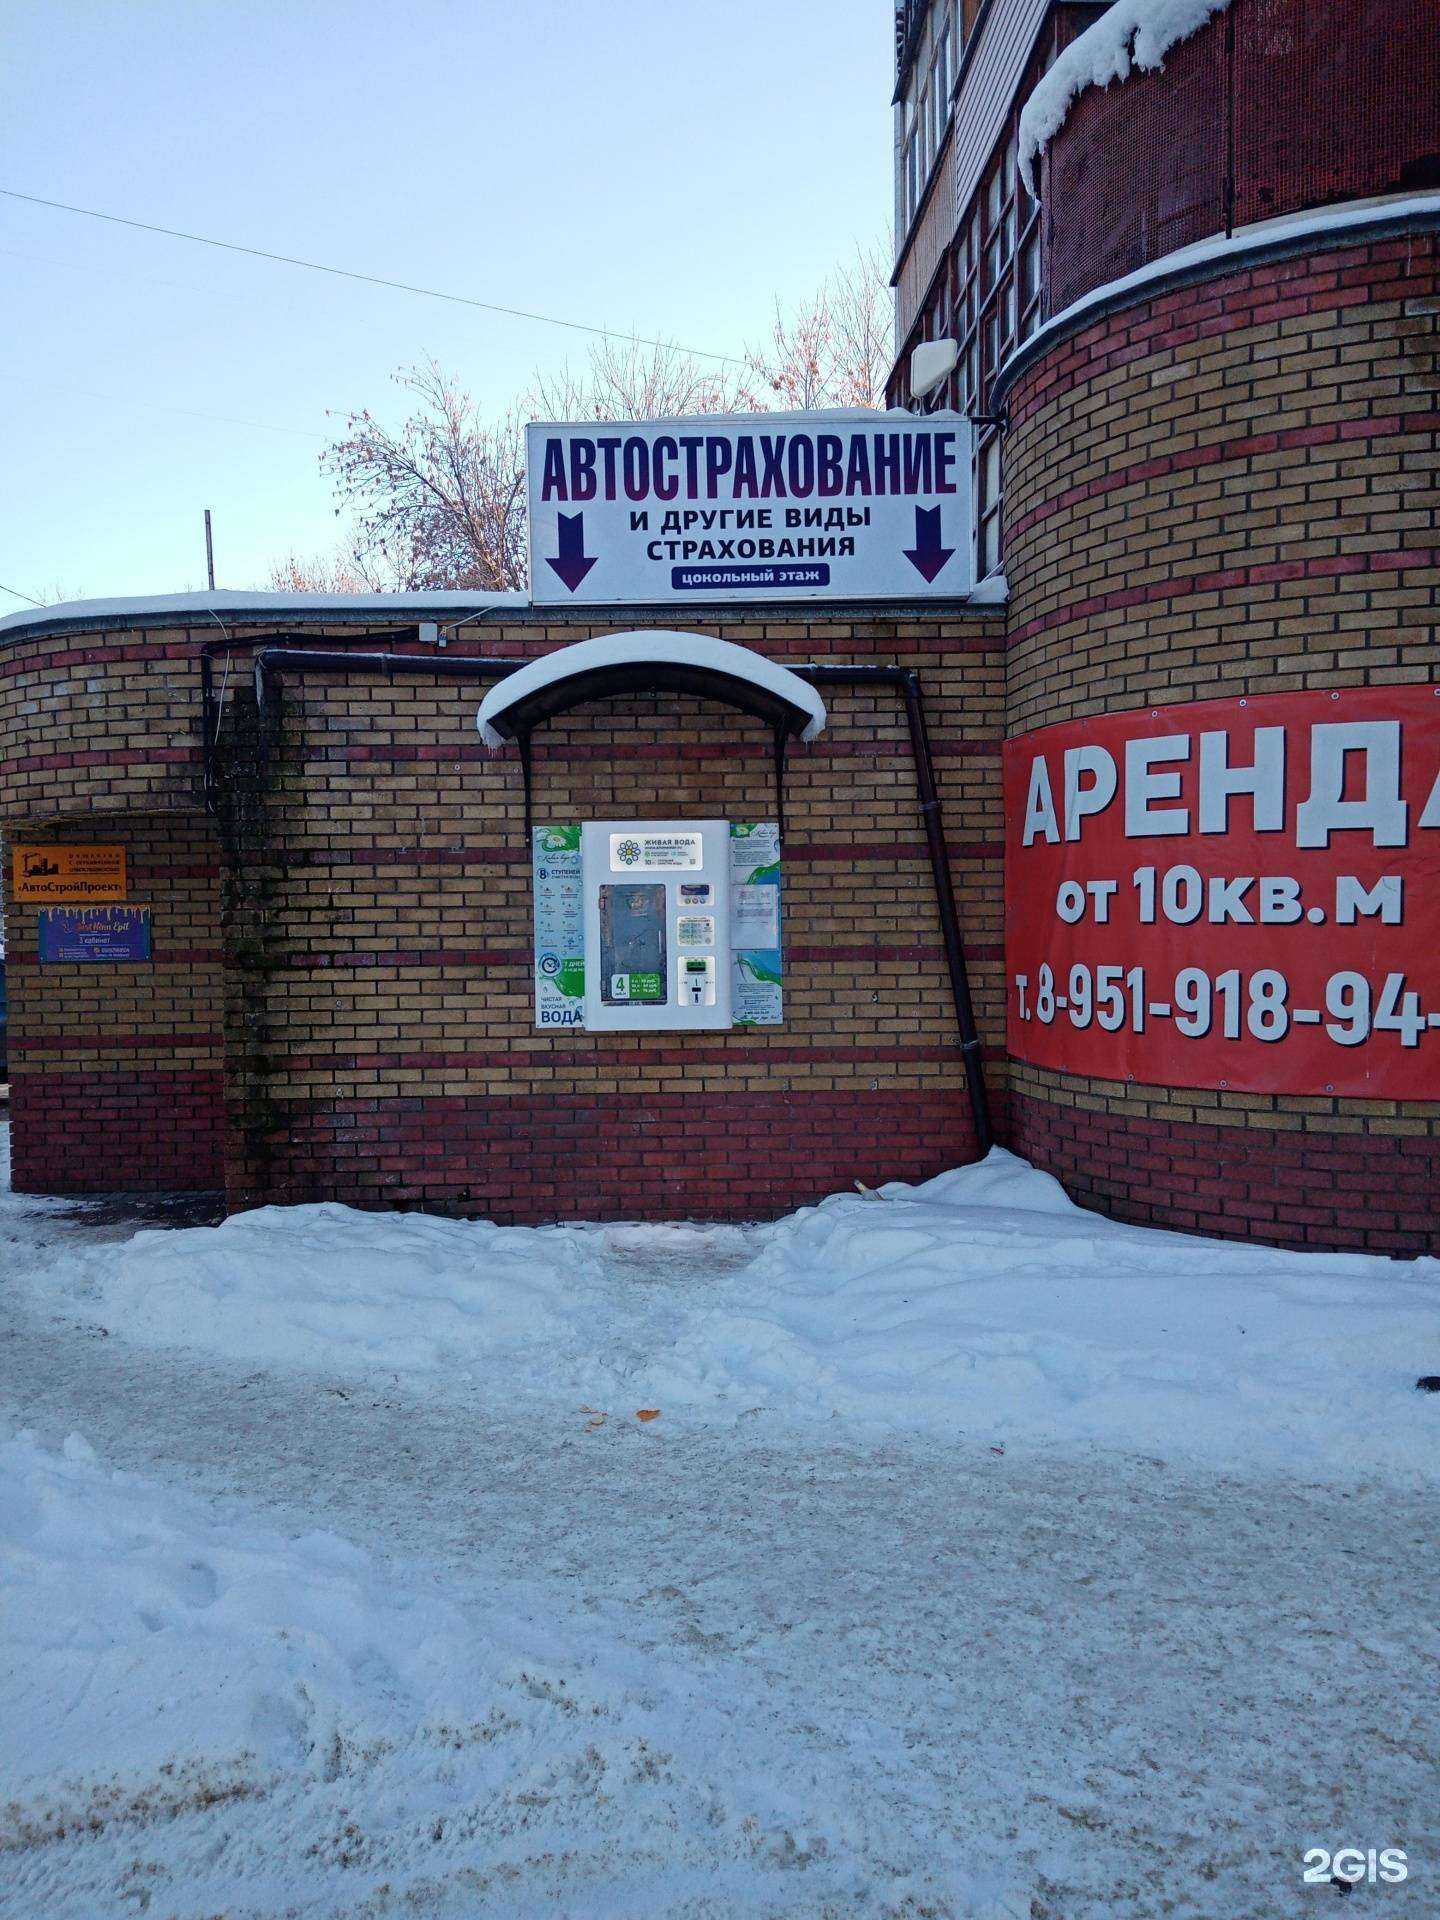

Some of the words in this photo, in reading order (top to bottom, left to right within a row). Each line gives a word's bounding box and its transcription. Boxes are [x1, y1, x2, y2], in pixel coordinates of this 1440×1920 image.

[541, 432, 957, 502] АВТОСТРАХОВАНИЕ
[629, 510, 648, 532] И
[660, 508, 774, 536] ДРУГИЕ
[785, 506, 872, 531] ВИДЫ
[646, 536, 856, 562] СТРАХОВАНИЯ
[681, 567, 776, 586] цокольный
[778, 569, 820, 583] этаж
[1055, 879, 1118, 924] от
[615, 977, 625, 992] 4
[541, 1010, 583, 1026] ВОДА
